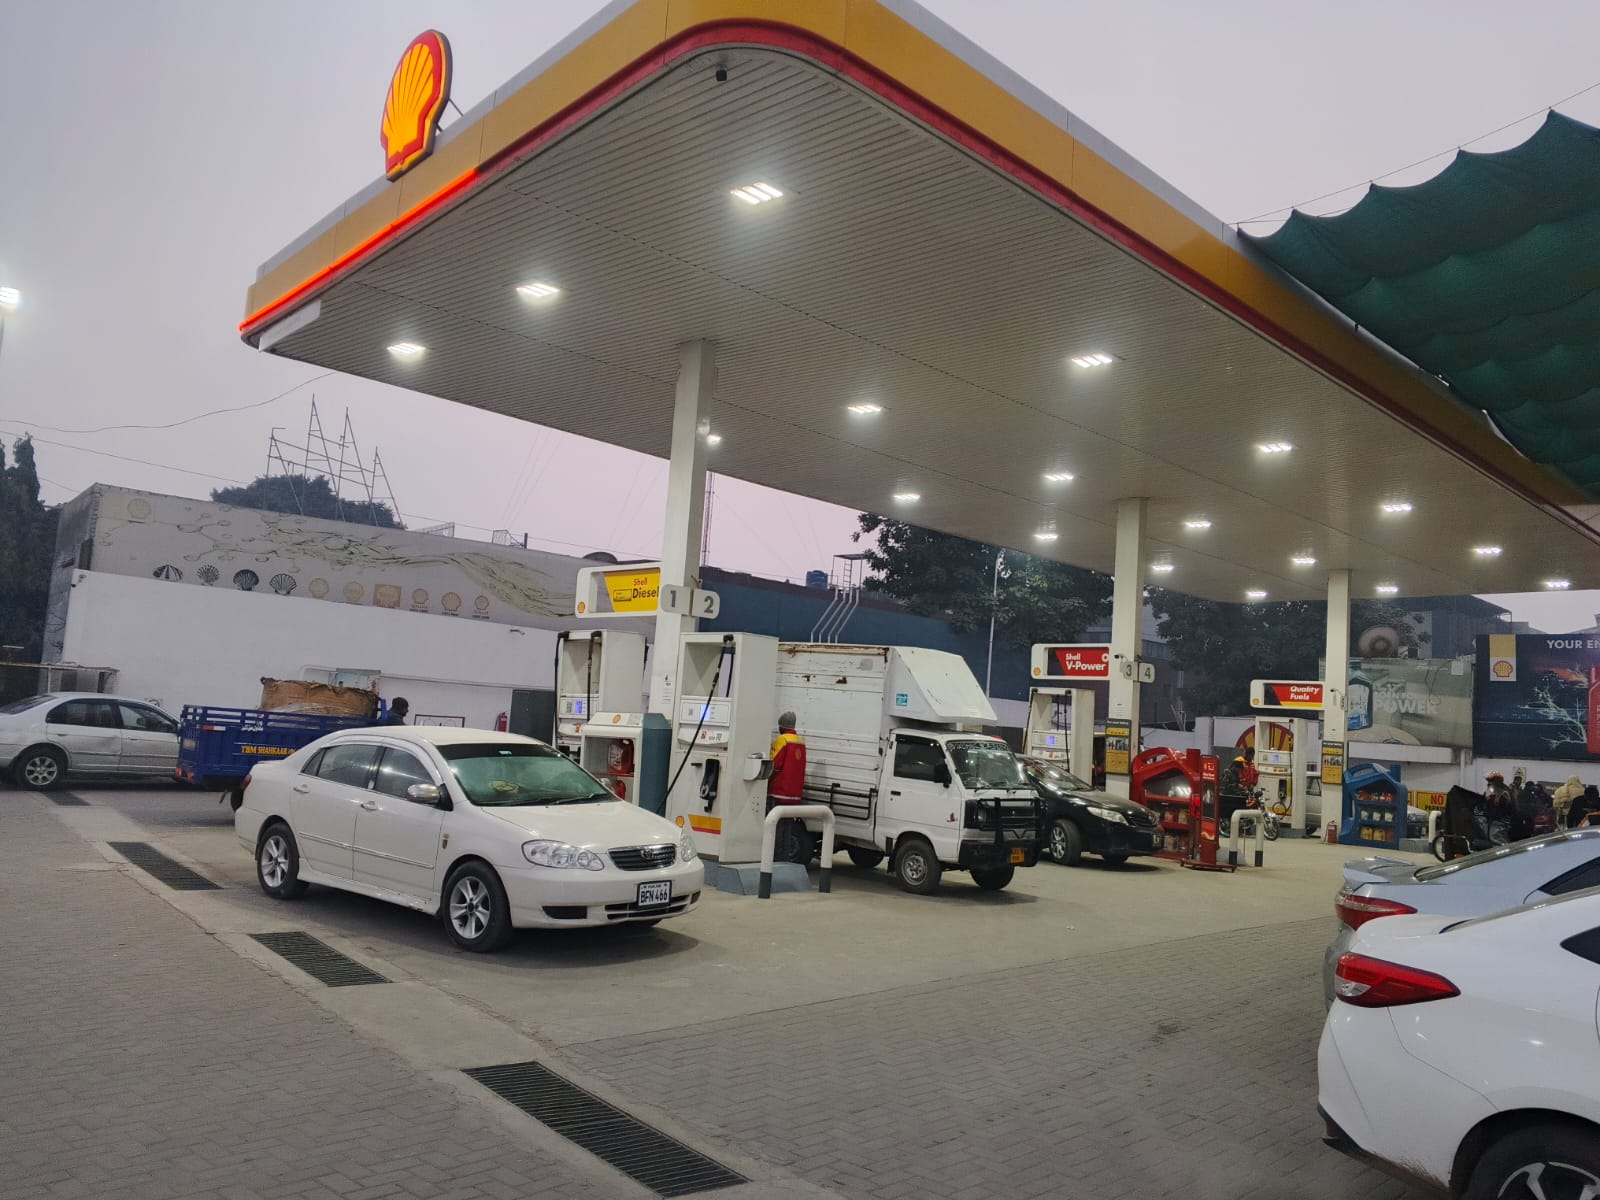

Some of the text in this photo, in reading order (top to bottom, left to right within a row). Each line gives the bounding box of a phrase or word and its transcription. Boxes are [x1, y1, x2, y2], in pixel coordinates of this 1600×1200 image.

[633, 577, 647, 586] Shell
[632, 586, 659, 599] Diesel
[670, 590, 677, 608] 1
[703, 596, 714, 614] 2
[1546, 640, 1582, 649] YOUR
[1065, 653, 1081, 661] Shell
[1065, 661, 1106, 671] V-Power
[1125, 664, 1133, 677] 3
[1144, 667, 1151, 679] 4
[1290, 686, 1320, 695] Quality
[1374, 699, 1438, 715] POWER
[1430, 794, 1444, 806] NO
[641, 888, 668, 903] BFN 466
